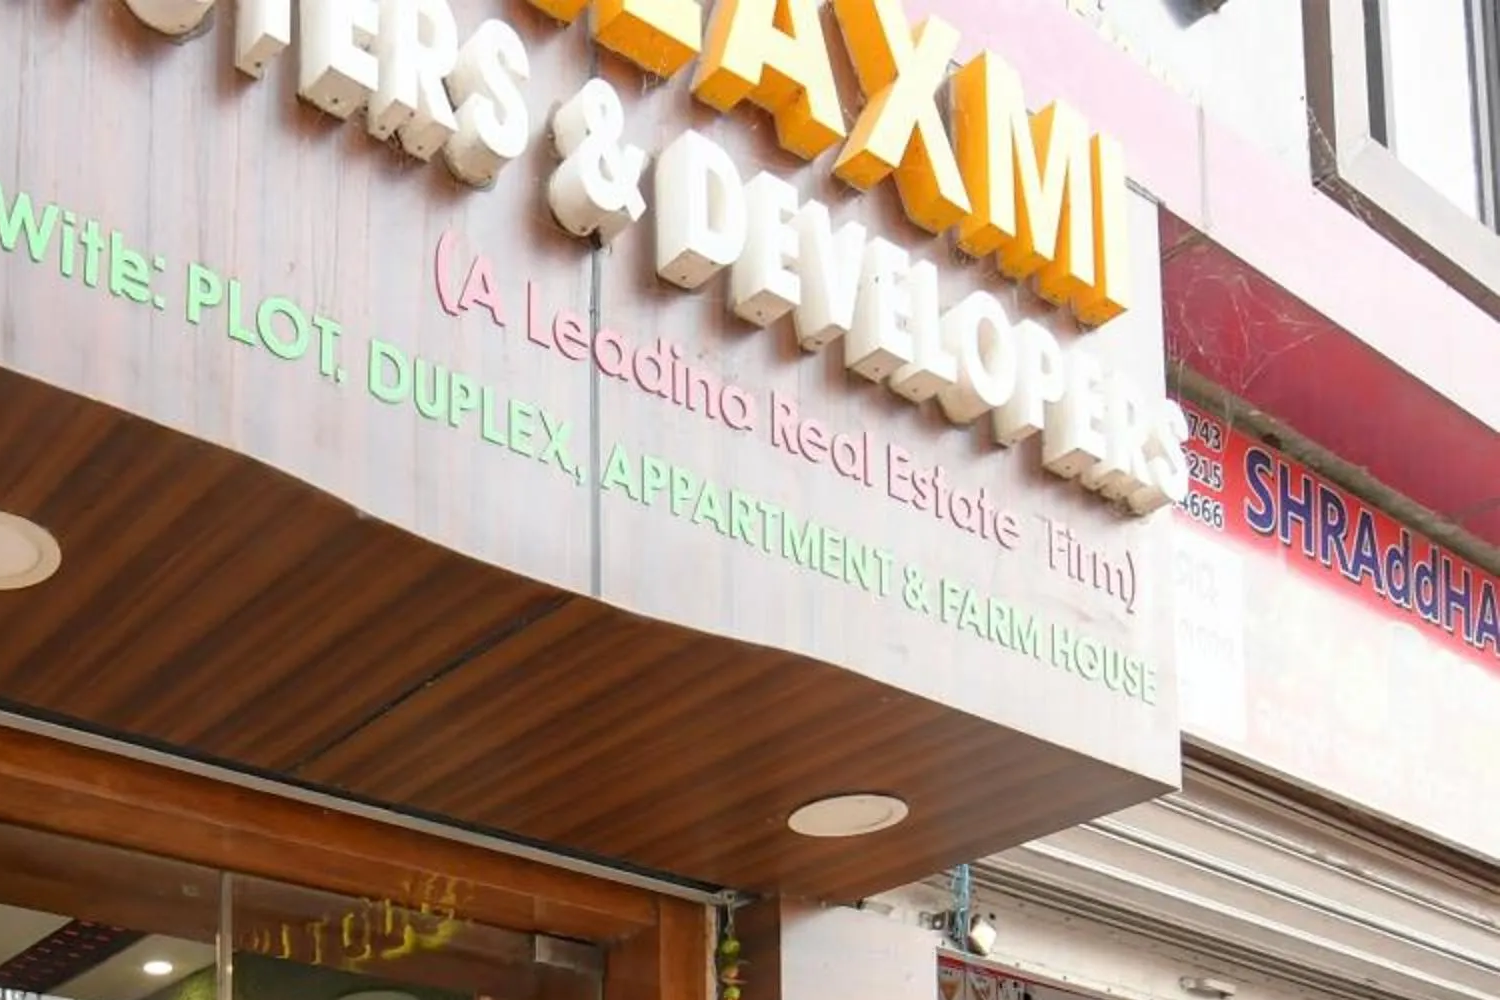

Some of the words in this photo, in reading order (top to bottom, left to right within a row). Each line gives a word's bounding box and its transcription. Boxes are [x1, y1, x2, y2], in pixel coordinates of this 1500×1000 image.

[528, 0, 1128, 325] AXMI
[434, 230, 506, 328] (A
[771, 388, 875, 488] Real
[886, 443, 1022, 552] Estate
[548, 76, 648, 238] &
[655, 128, 1190, 516] DEVELOPERS
[1174, 490, 1224, 530] 4666
[1181, 446, 1223, 492] 215
[1183, 408, 1222, 452] 743
[601, 442, 896, 598] APPARTMENT
[903, 561, 930, 616] &
[938, 575, 1043, 661] FARM
[1050, 622, 1160, 707] HOUSE
